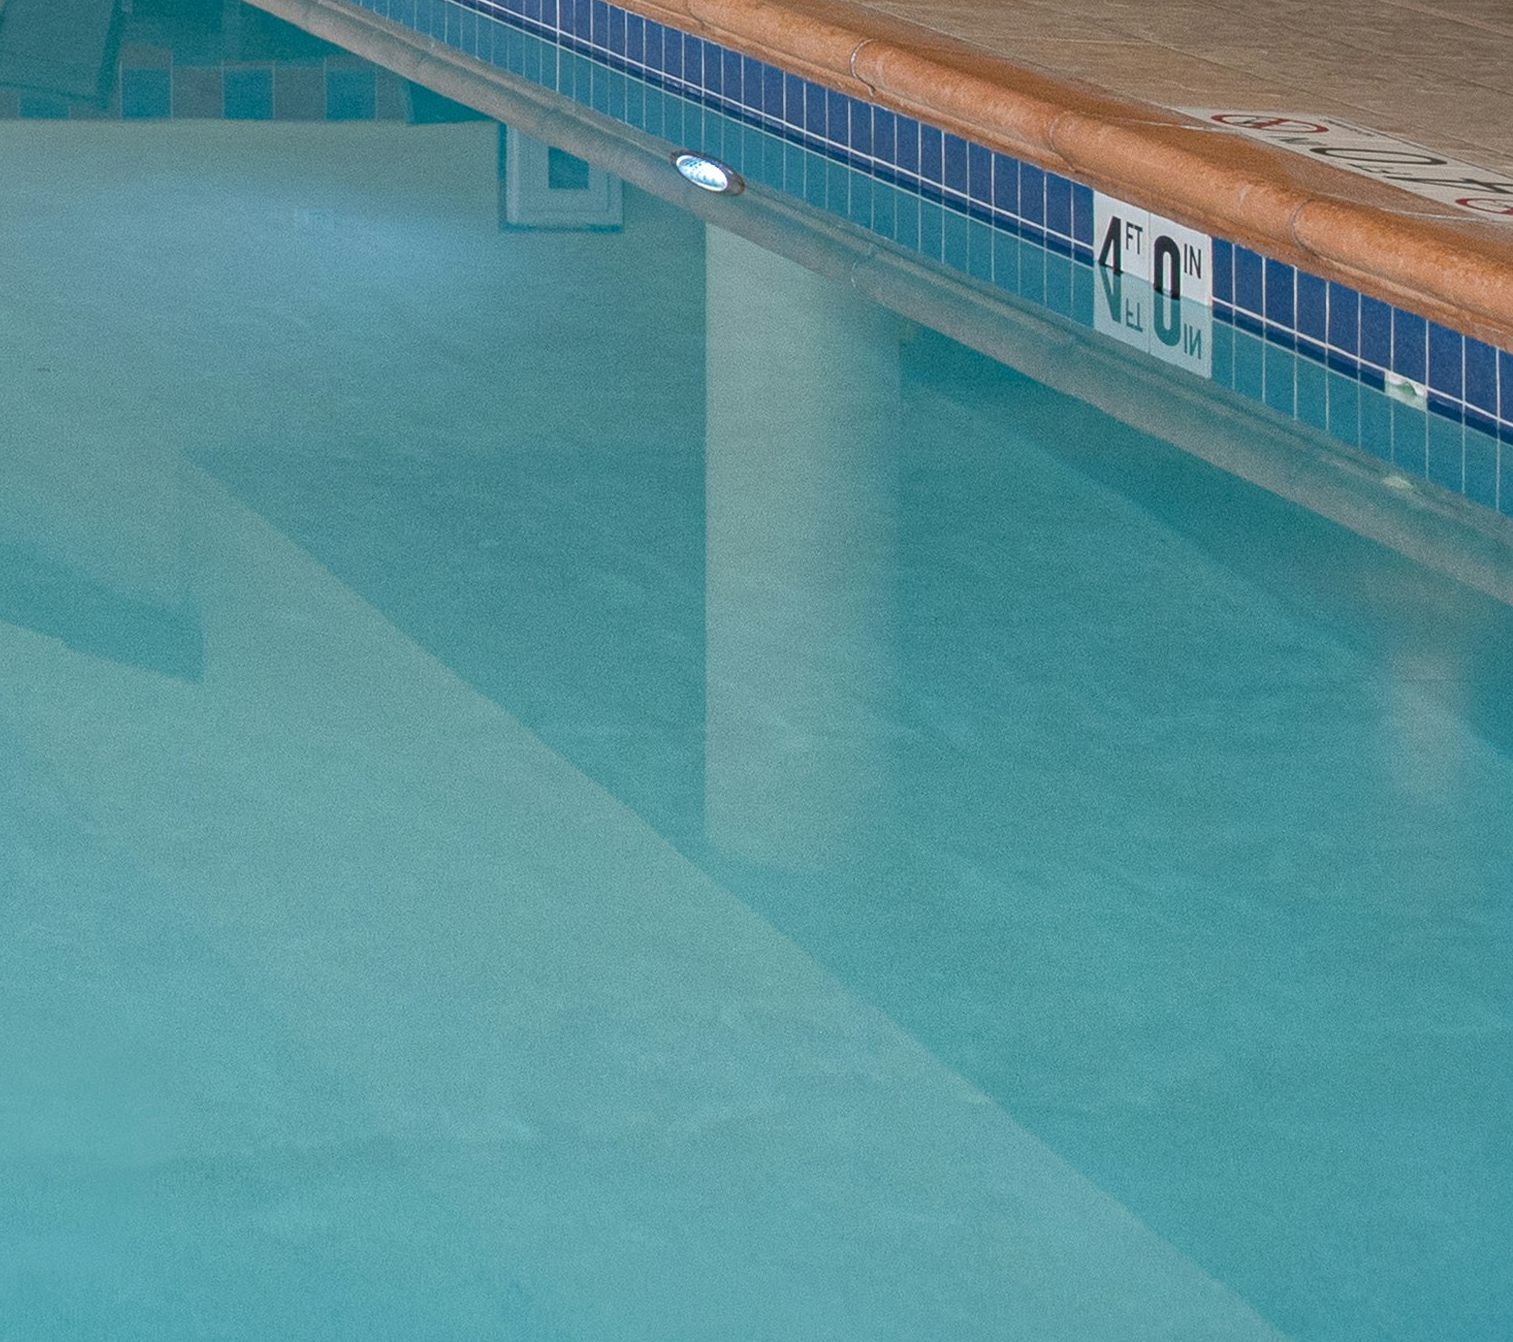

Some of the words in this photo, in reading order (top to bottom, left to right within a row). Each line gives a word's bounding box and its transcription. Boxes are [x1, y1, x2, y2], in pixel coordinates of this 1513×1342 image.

[1097, 215, 1124, 275] 4
[1125, 221, 1143, 255] FT
[1184, 243, 1202, 280] IN
